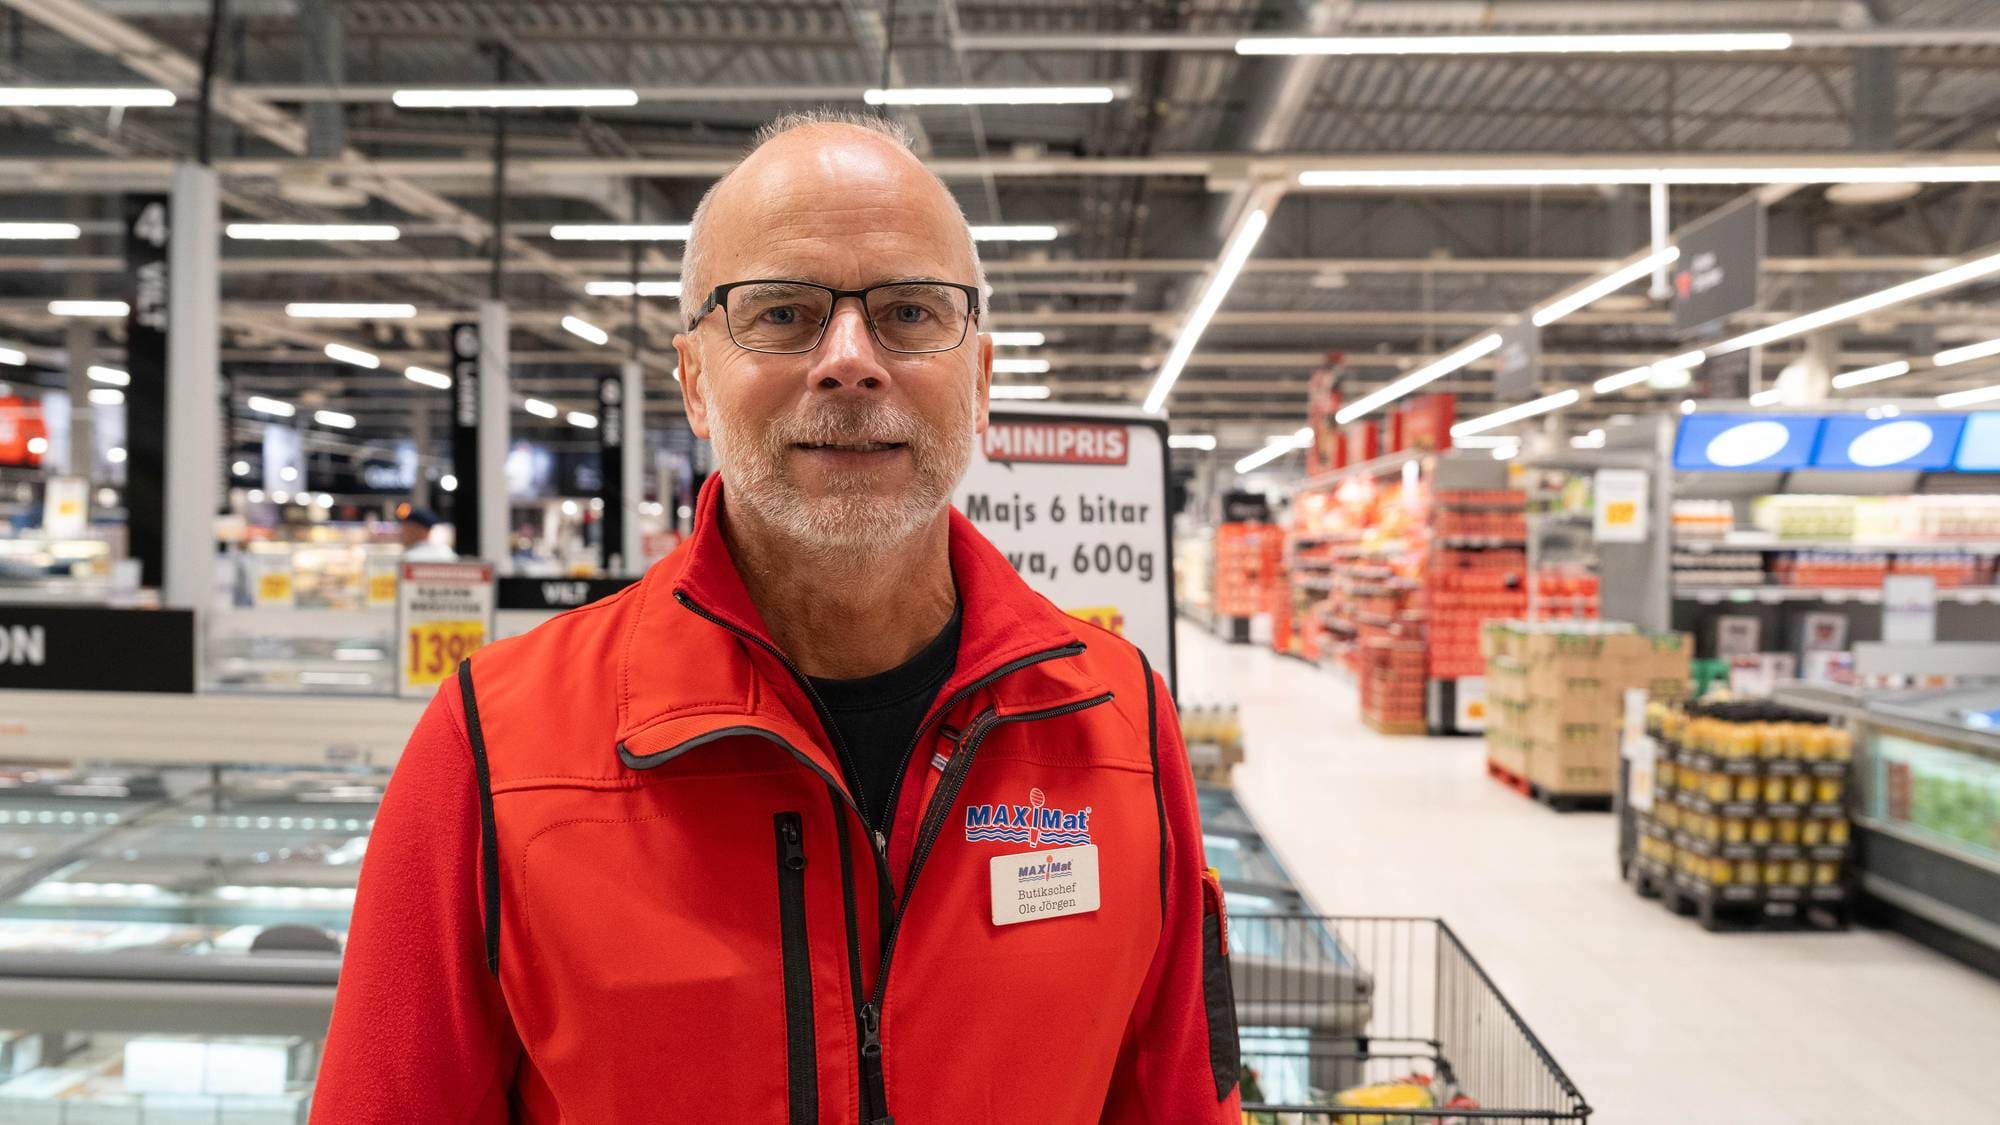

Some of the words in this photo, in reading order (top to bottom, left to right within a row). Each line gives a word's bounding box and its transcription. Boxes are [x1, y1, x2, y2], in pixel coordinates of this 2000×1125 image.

[134, 202, 168, 247] 4
[986, 426, 1125, 458] MINIPRIS
[966, 494, 1037, 531] Majs
[1050, 496, 1066, 523] 6
[1079, 496, 1150, 524] bitar
[1072, 543, 1155, 583] 600g
[1018, 882, 1077, 901] Butikschef
[1018, 901, 1036, 915] Ole
[1039, 898, 1076, 913] Jörgen
